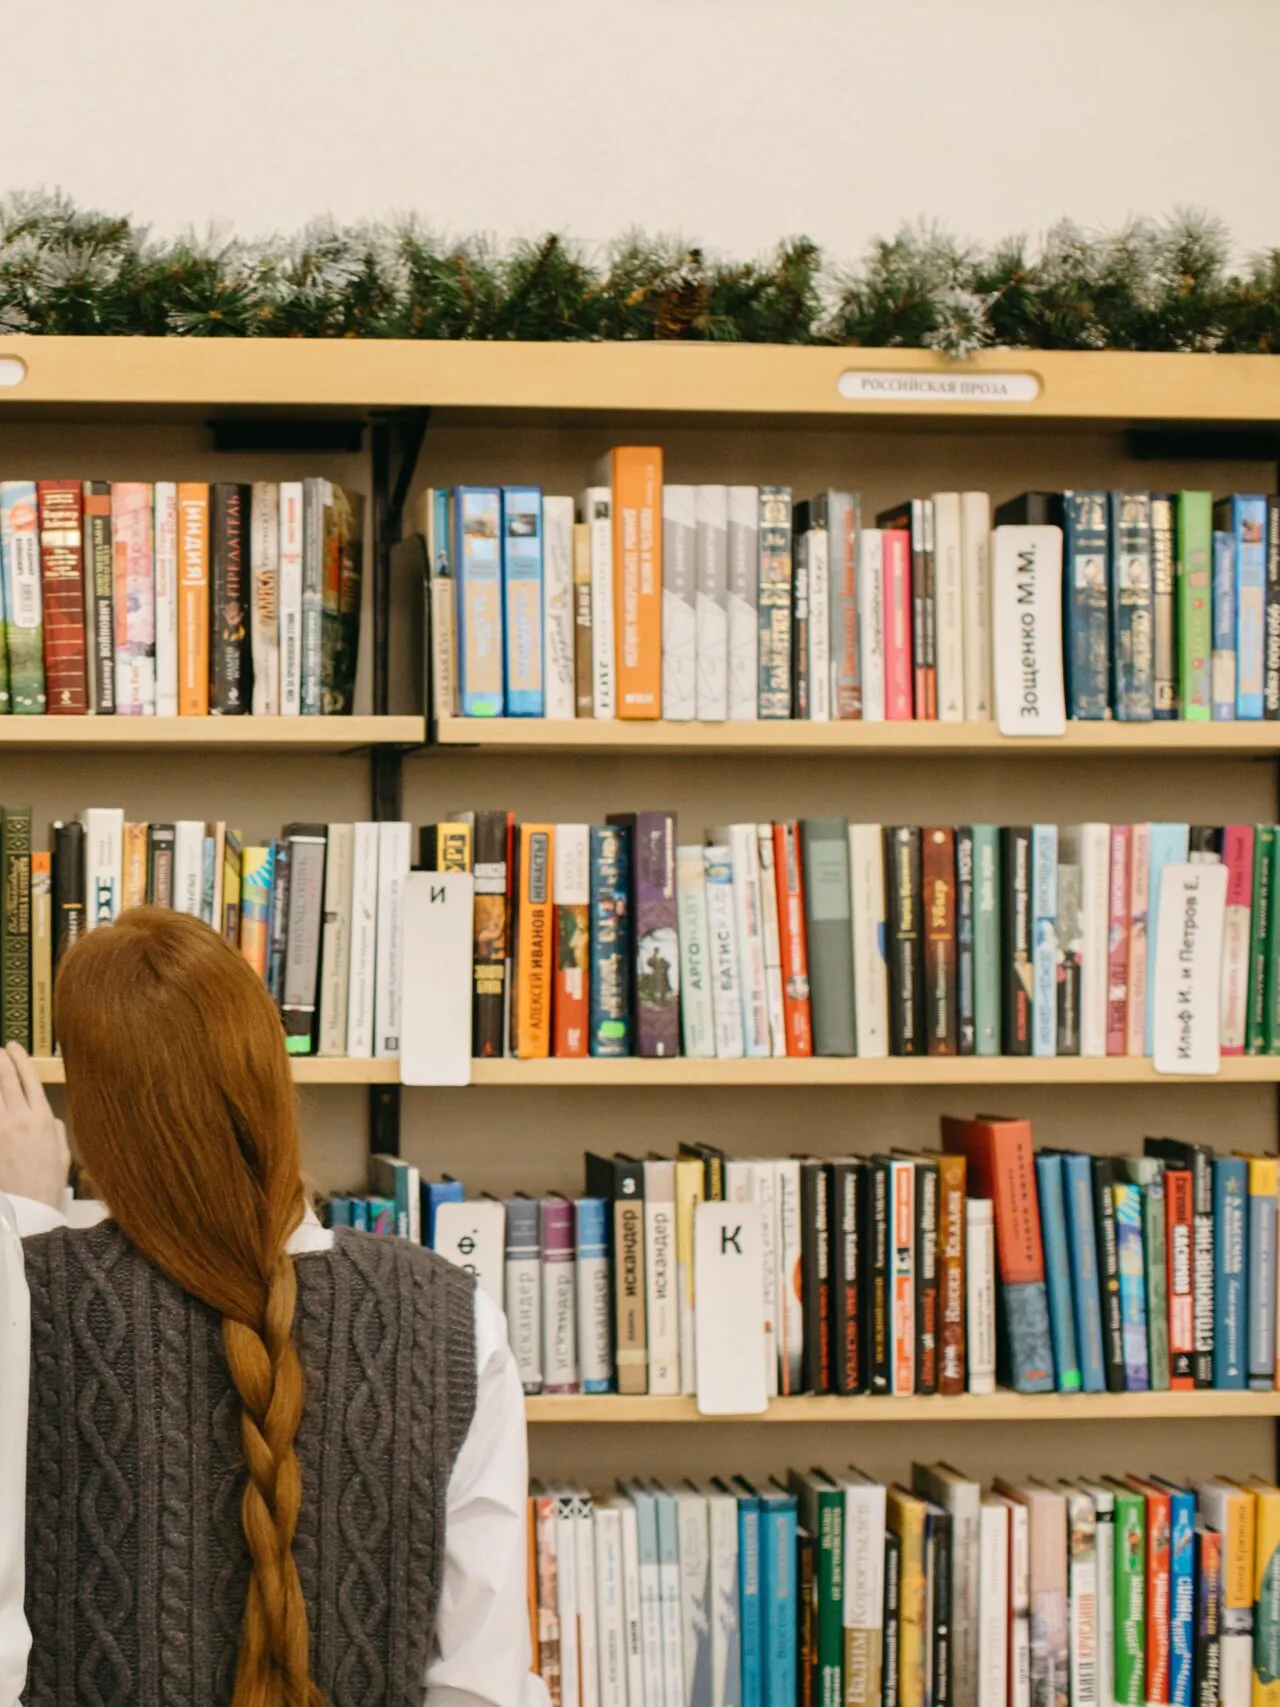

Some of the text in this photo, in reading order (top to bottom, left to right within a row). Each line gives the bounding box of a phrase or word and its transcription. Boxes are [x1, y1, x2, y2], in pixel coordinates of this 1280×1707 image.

[99, 600, 111, 657] ВОЙНОВИЧ
[1017, 543, 1040, 718] Зощенко М.М.
[429, 885, 445, 904] И
[531, 909, 545, 968] ИВАНОВ
[686, 893, 703, 991] АРГОНАВТ
[1176, 875, 1204, 1060] Ильф И. и Петров Е.
[530, 972, 544, 1030] АЛЕКСЕЙ
[621, 1210, 638, 1298] искандер
[653, 1212, 670, 1300] искандер
[721, 1225, 743, 1255] К
[1195, 1215, 1213, 1351] СТОЛКНОВЕНИЕ
[516, 1272, 534, 1368] искандер
[553, 1275, 572, 1370] искандер
[848, 1631, 867, 1703] Вадим
